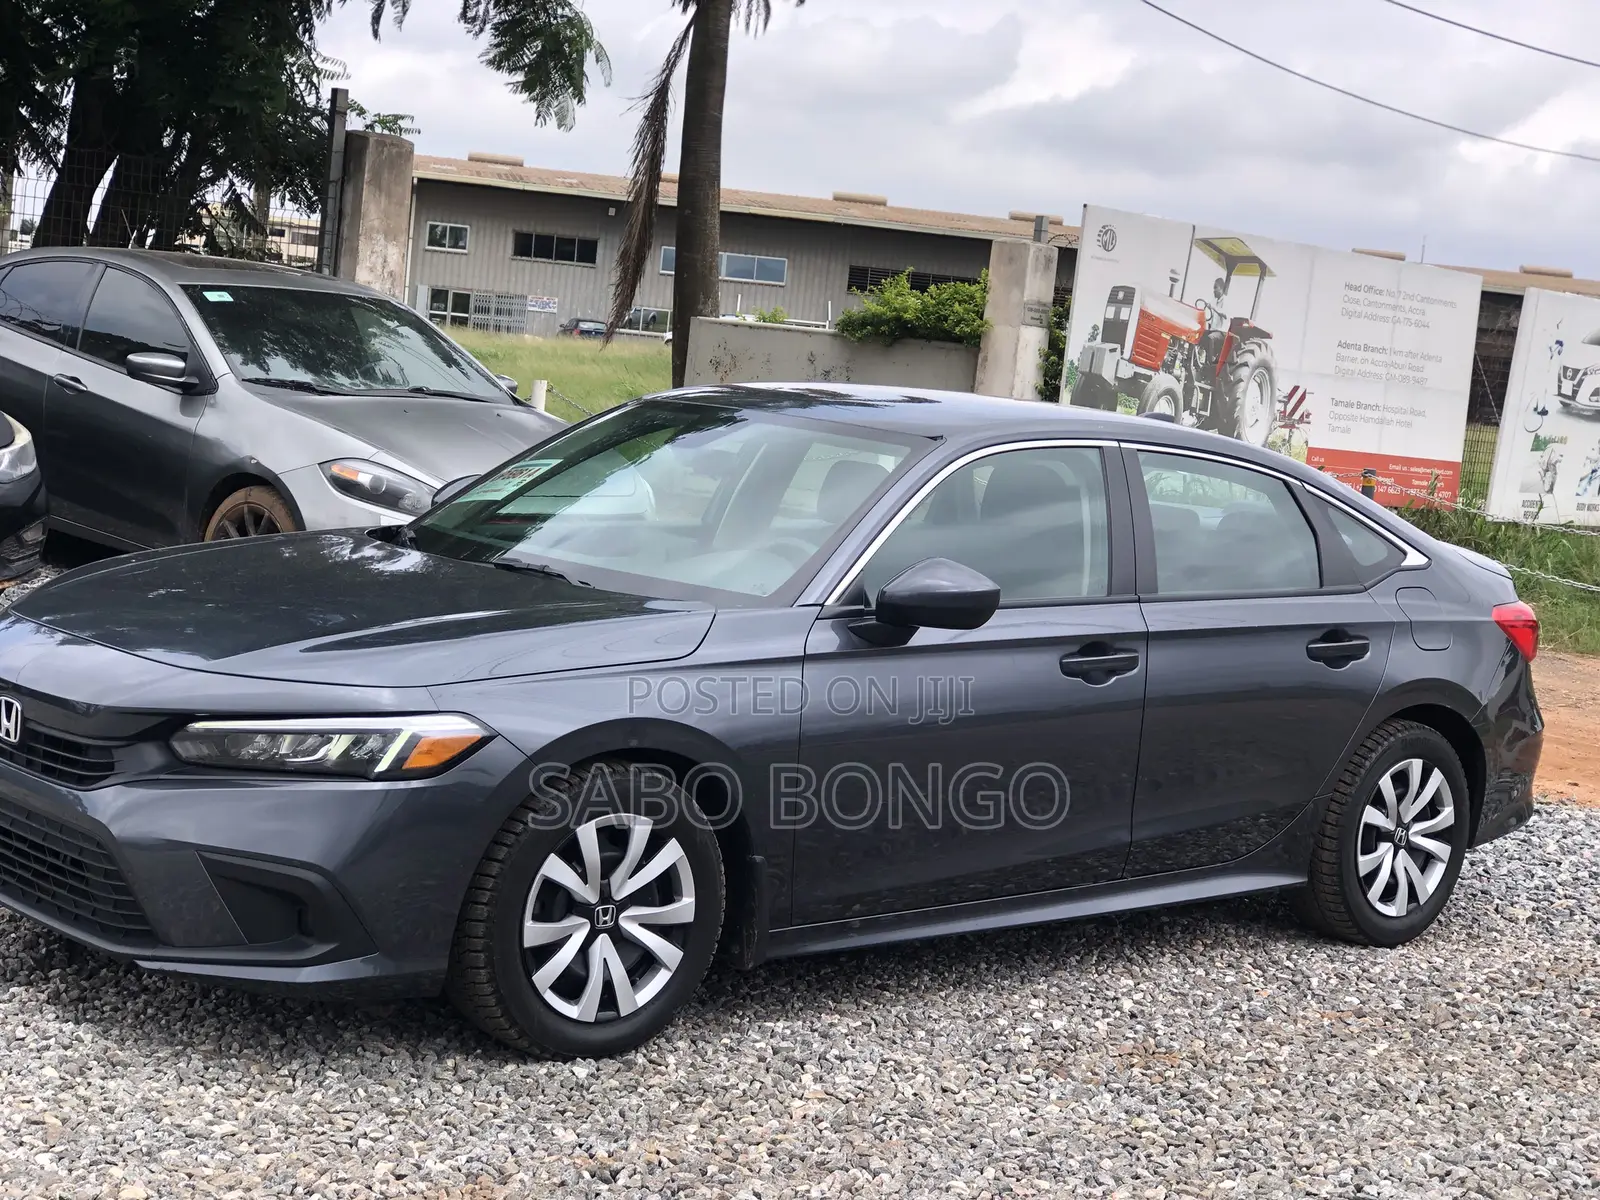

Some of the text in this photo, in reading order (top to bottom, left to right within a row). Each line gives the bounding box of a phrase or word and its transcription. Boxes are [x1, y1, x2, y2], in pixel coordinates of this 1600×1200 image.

[1344, 281, 1362, 293] Head
[1363, 284, 1385, 296] Office:
[1402, 291, 1415, 302] 2nd
[1416, 293, 1458, 309] Cantonments
[1341, 307, 1363, 319] Digital
[1362, 297, 1408, 314] Cantonments,
[1408, 305, 1426, 316] Accra
[1337, 340, 1362, 352] Adenta
[1363, 343, 1389, 355] Branch:
[1393, 347, 1404, 357] km
[1404, 349, 1420, 359] after
[1420, 351, 1443, 363] Adenta
[1334, 365, 1356, 377] Digital
[1360, 356, 1369, 365] on
[1407, 362, 1425, 373] Road
[1331, 397, 1355, 409] Tamale
[1356, 400, 1381, 412] Branch:
[1382, 403, 1409, 416] Hospital
[1329, 410, 1359, 423] Opposite
[1395, 419, 1413, 429] Hotel
[1328, 423, 1351, 435] Tamale
[1389, 463, 1402, 471] Email
